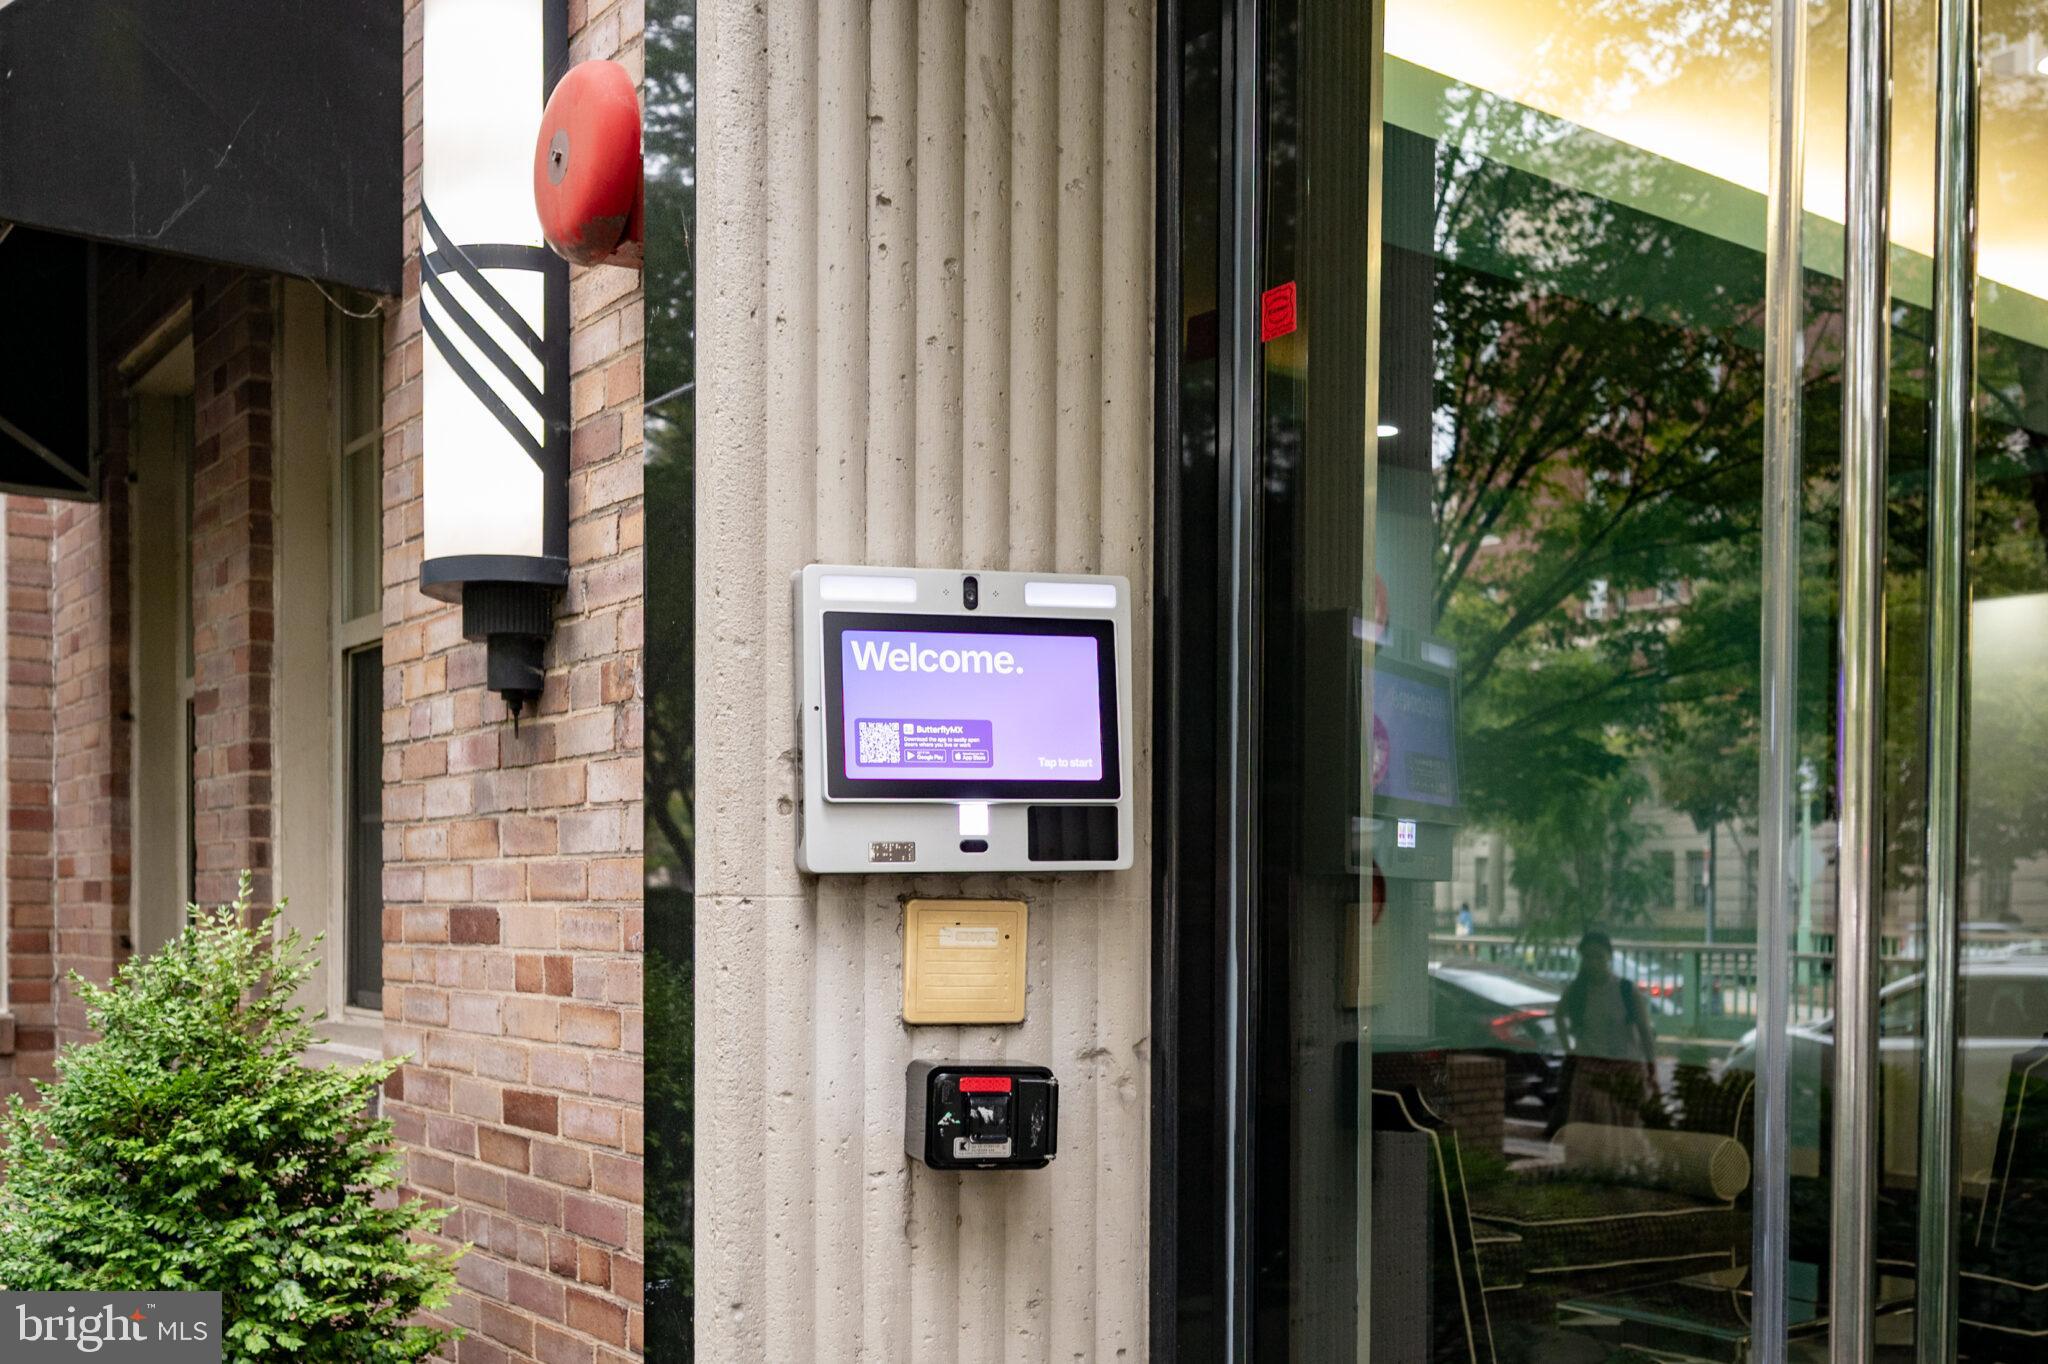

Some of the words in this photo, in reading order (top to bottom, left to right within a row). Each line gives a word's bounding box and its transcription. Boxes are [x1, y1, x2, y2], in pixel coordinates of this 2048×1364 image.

[850, 639, 1024, 675] Welcome.
[916, 725, 964, 735] ButterflyMX
[1038, 757, 1056, 769] Tap
[1058, 758, 1069, 768] to
[1069, 758, 1093, 768] start
